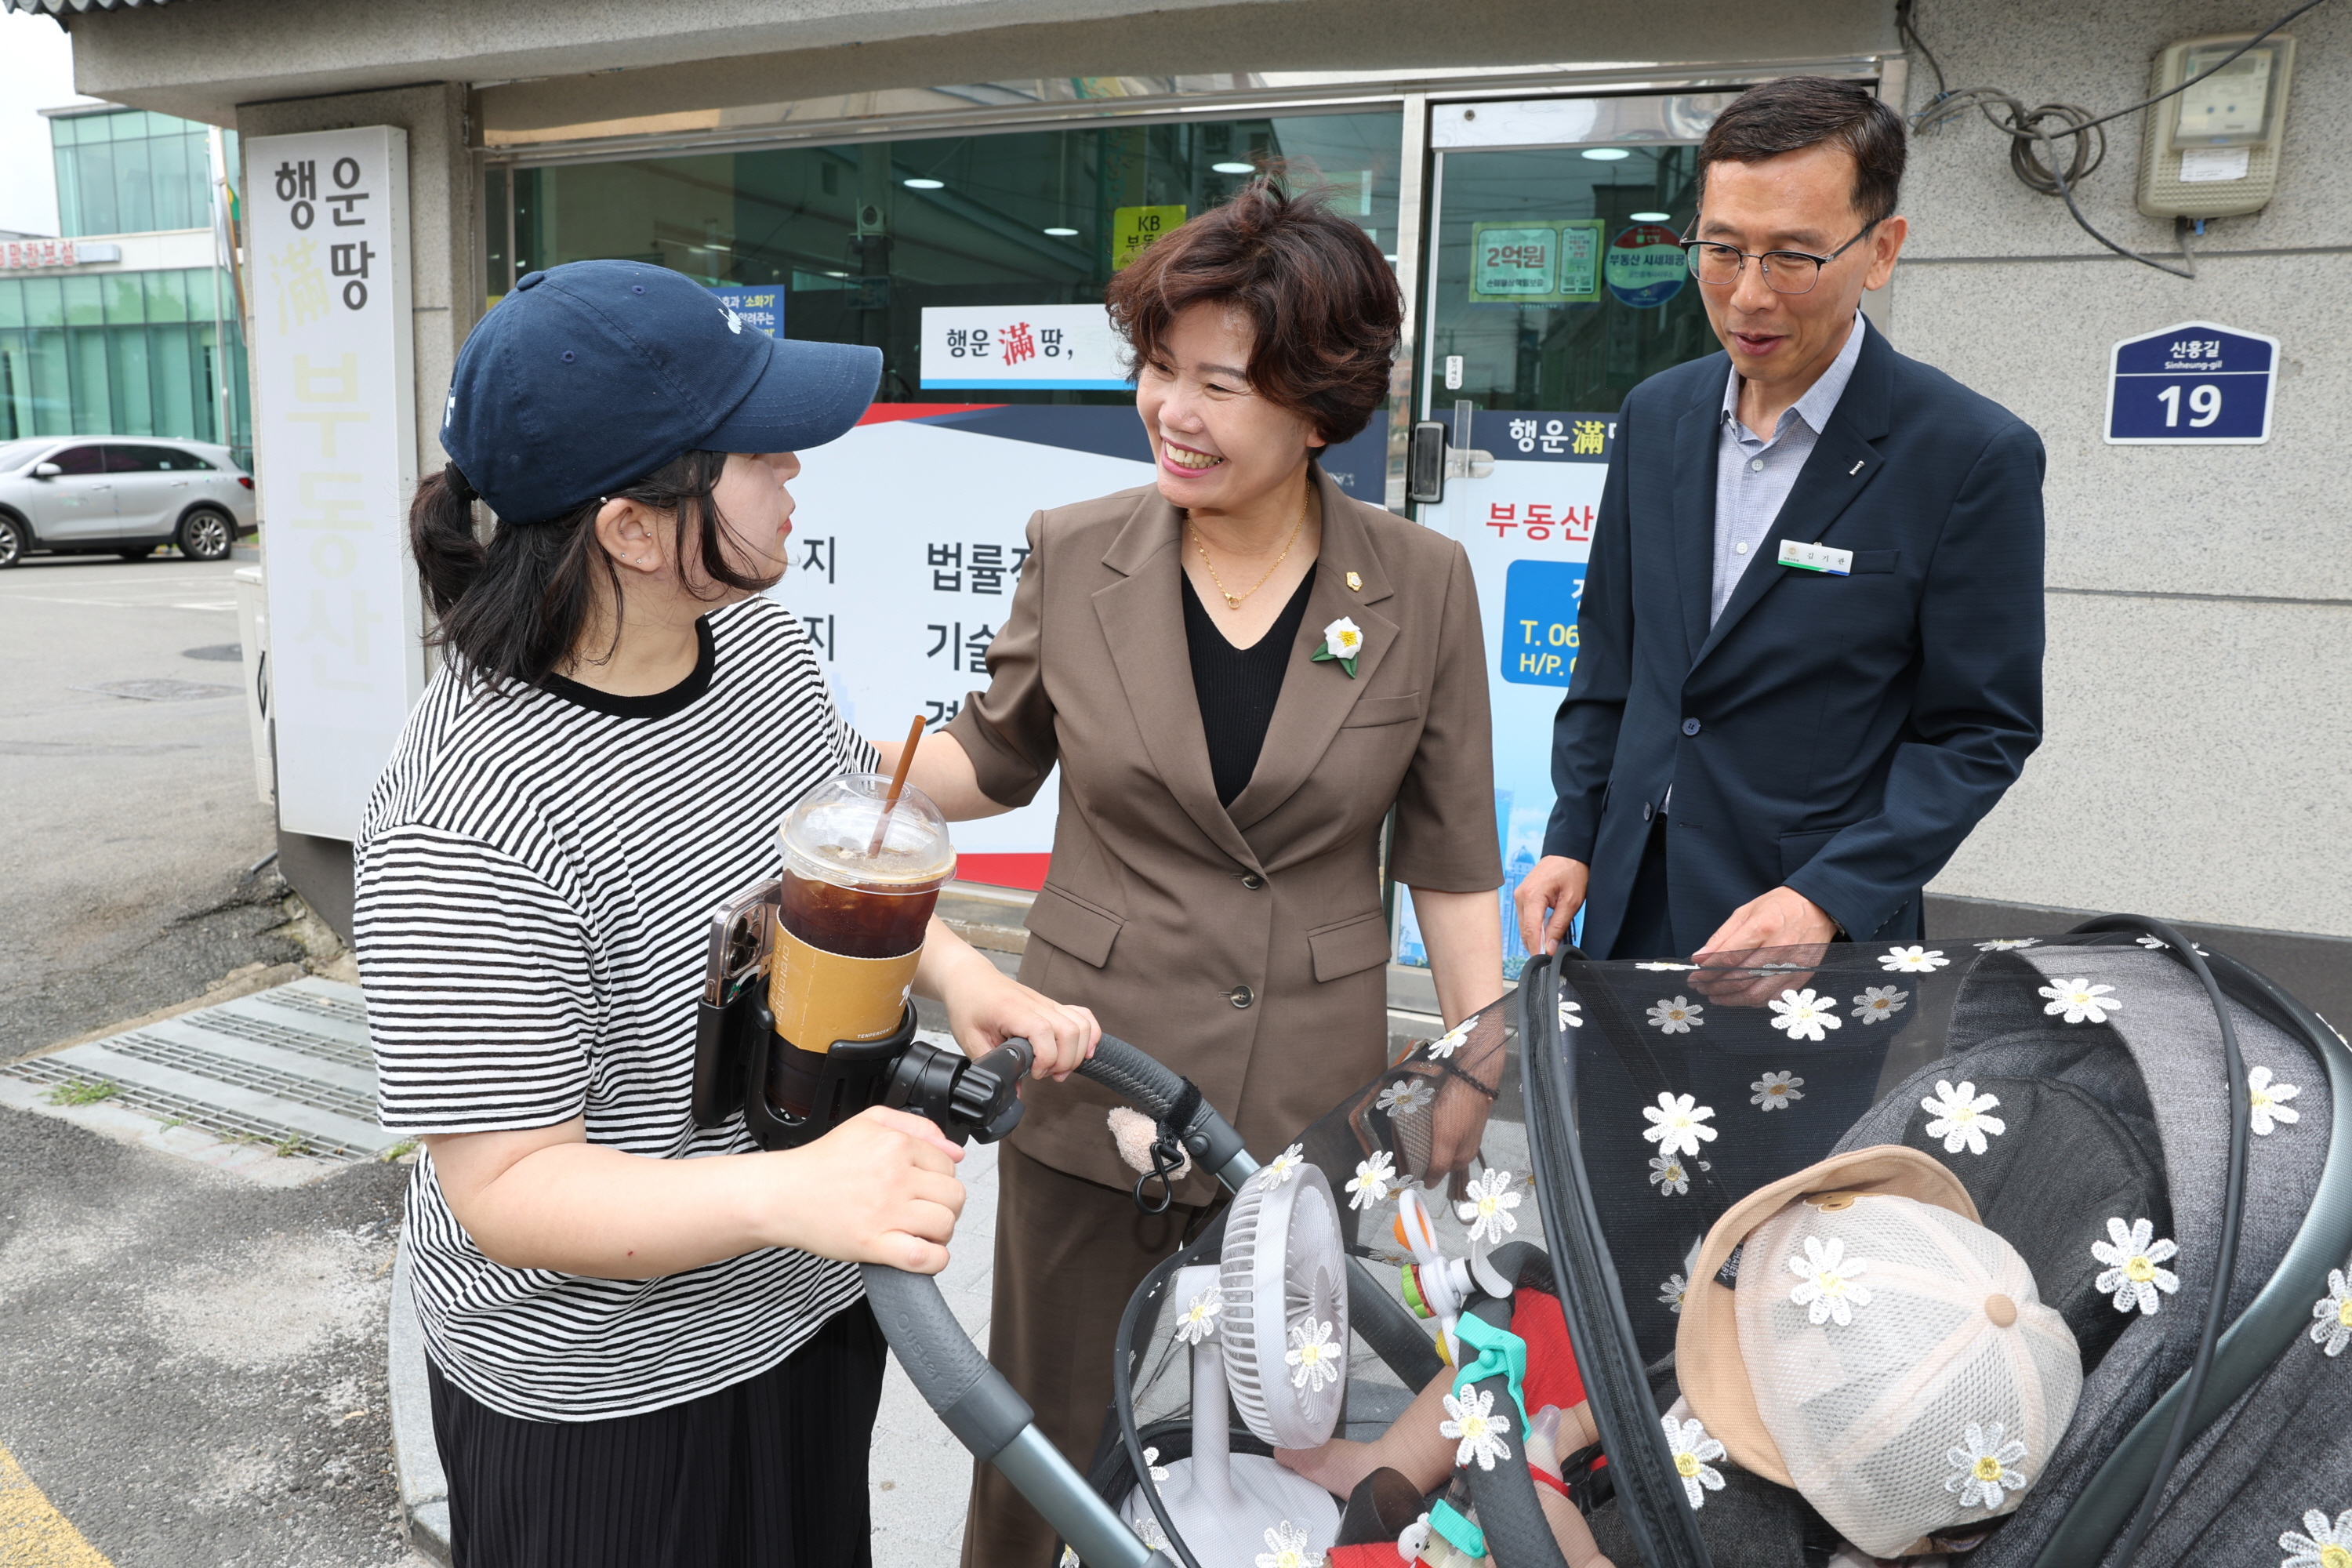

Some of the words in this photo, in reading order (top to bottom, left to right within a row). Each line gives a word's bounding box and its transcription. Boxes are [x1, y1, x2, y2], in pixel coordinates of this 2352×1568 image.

[275, 157, 369, 230] 행운
[1138, 216, 1160, 231] KB
[1126, 234, 1155, 252] 부동
[1486, 245, 1545, 269] 2억원
[1610, 253, 1640, 267] 부동산
[1643, 253, 1685, 267] 시세제공
[2170, 340, 2220, 359] 신흥길
[2164, 360, 2223, 370] Sinheung-gil
[2157, 384, 2222, 427] 19
[1509, 418, 1617, 455] 행운滿
[285, 352, 383, 693] 부동산
[1486, 503, 1594, 542] 부동산
[1519, 619, 1541, 646] T.
[1519, 652, 1564, 676] H/P.
[857, 1026, 892, 1039] TENPERCENT
